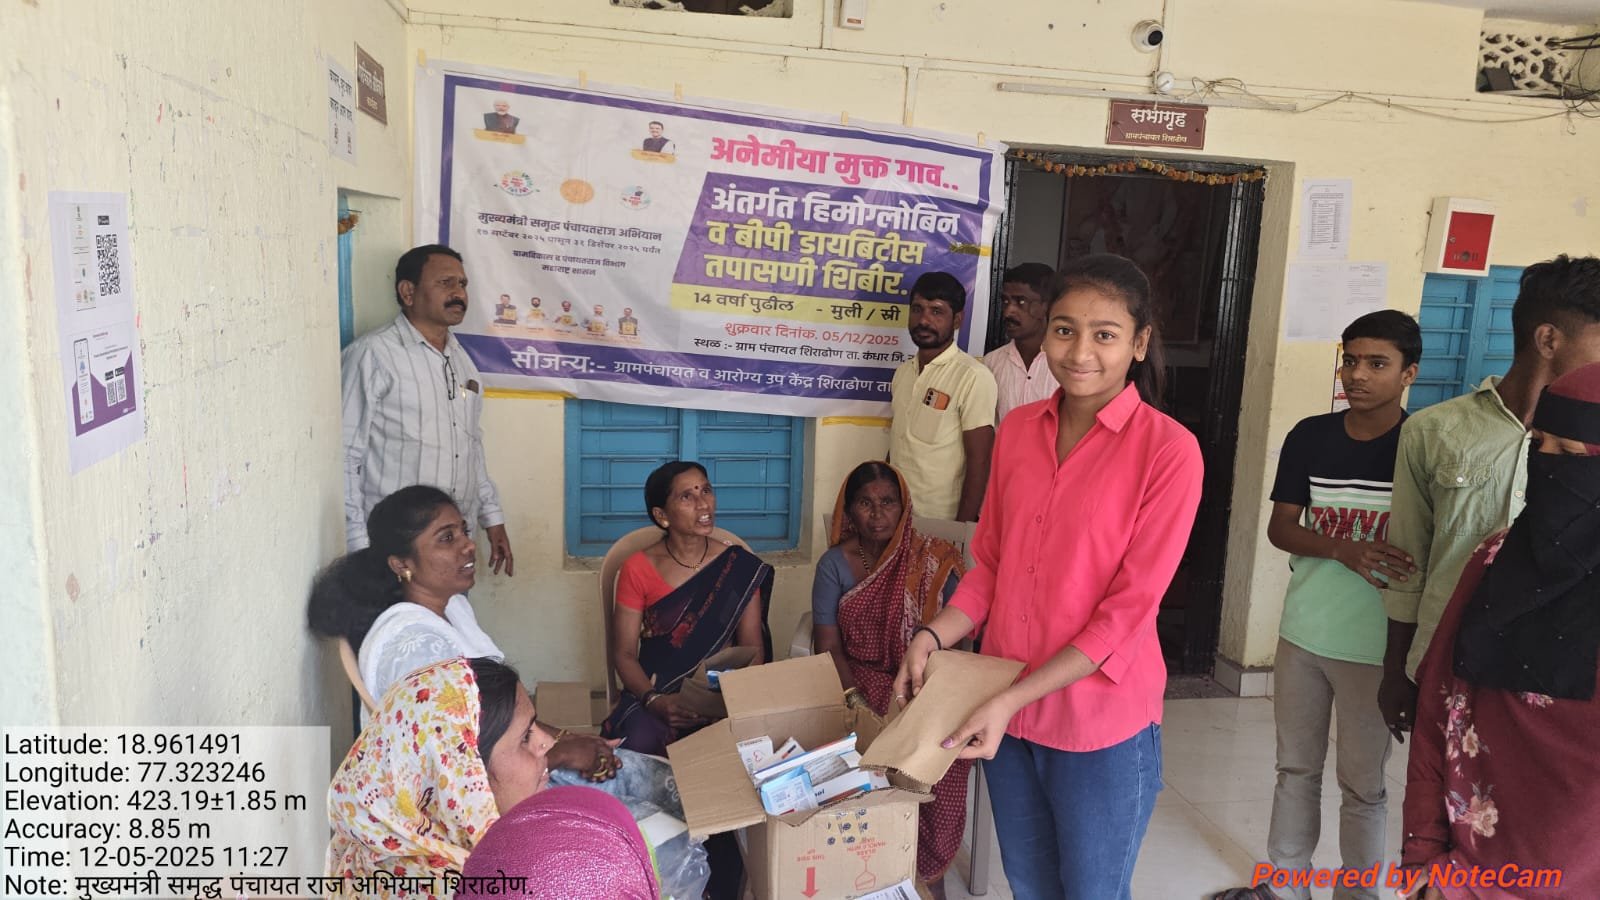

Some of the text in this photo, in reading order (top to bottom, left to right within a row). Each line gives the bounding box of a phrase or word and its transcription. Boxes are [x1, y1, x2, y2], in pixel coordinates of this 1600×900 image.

[1131, 108, 1187, 130] सभागृह
[711, 134, 829, 173] अनेमीया
[834, 153, 891, 185] मुक्त
[712, 183, 960, 235] अंतर्गत हिमोग्लोबिन
[478, 212, 662, 241] मुख्यमंत्री समृद्ध पंचायतराज अभियान
[707, 219, 927, 265] व बीपी डायबिटीस
[704, 254, 908, 296] तपासणी शिबीर.
[694, 292, 711, 304] 14
[716, 292, 747, 308] वर्षा
[750, 295, 794, 313] पुढील
[831, 302, 863, 320] मुली
[724, 321, 899, 346] शुक्रवार दिनांक. 05/12/2025
[694, 338, 721, 348] स्थळ
[736, 342, 756, 353] ग्राम
[759, 342, 797, 355] पंचायत
[800, 344, 843, 359] शिराढोण
[863, 350, 890, 361] कंधार
[614, 361, 695, 379] ग्रामपंचायत
[698, 368, 711, 380] व
[713, 367, 762, 384] आरोग्य
[766, 373, 784, 385] उप
[788, 371, 813, 390] केंद्र
[817, 374, 873, 392] शिराढोण
